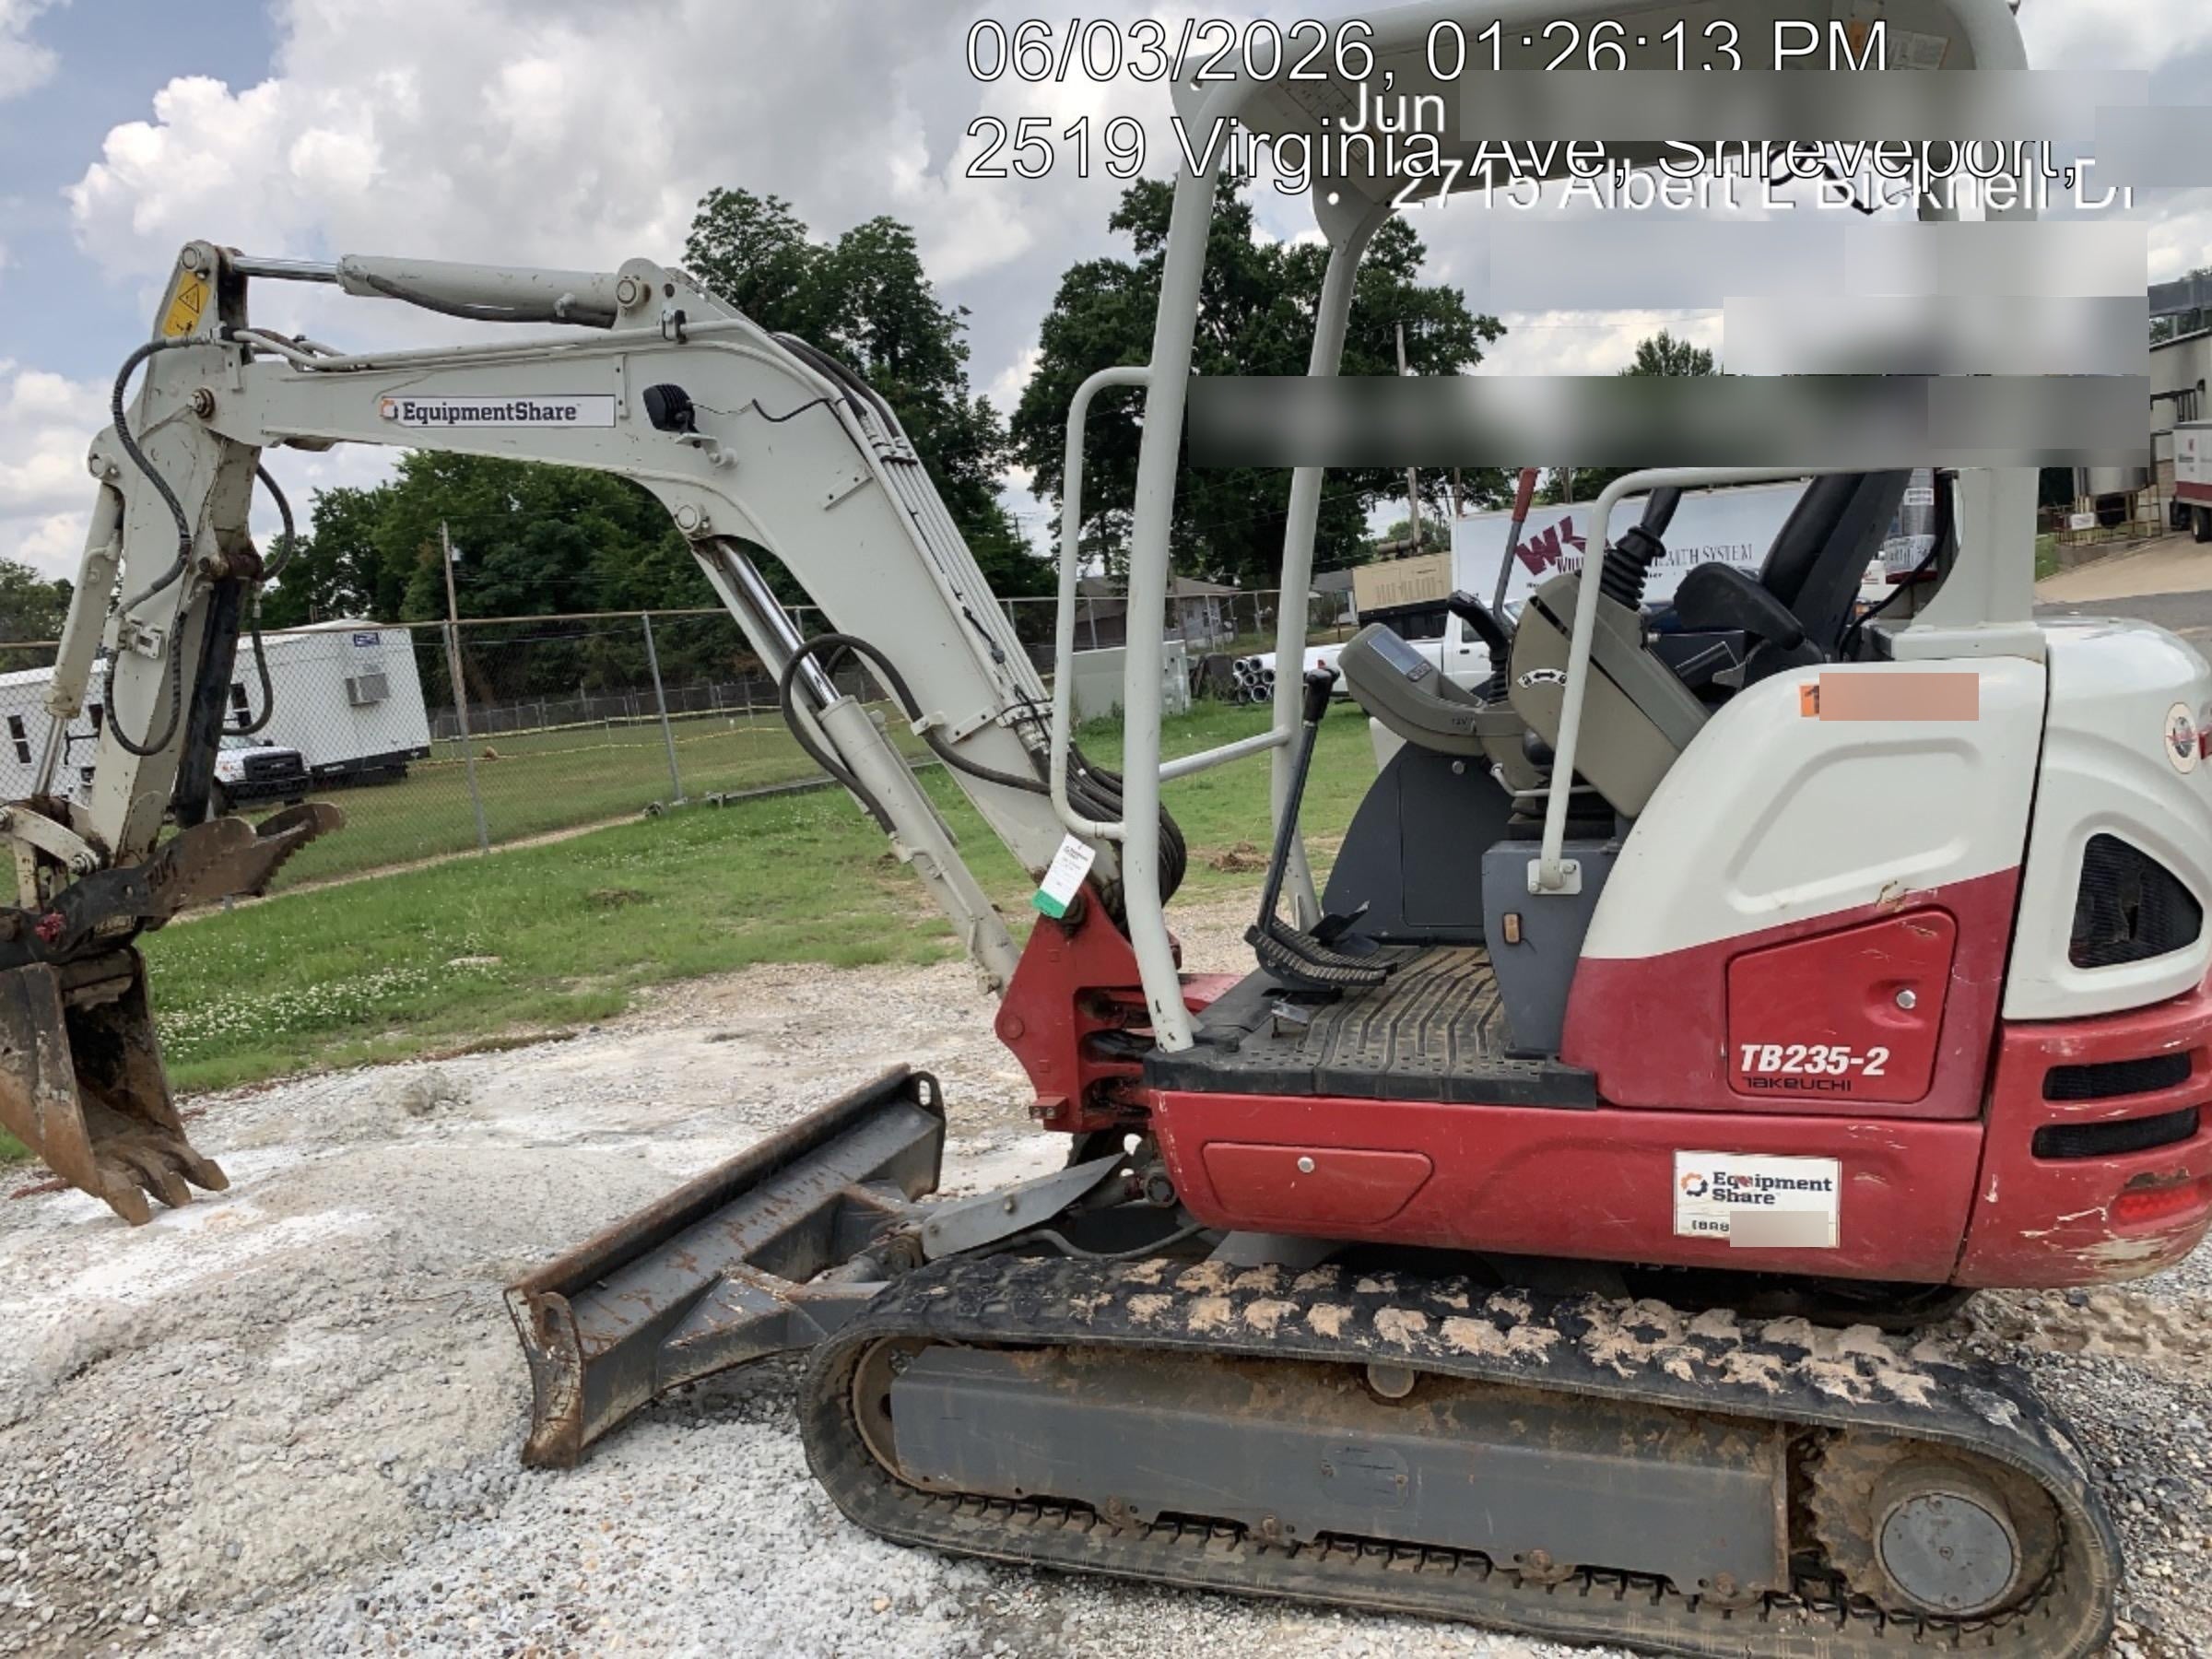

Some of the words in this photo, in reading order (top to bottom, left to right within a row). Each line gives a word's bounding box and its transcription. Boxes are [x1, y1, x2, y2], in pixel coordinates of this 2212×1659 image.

[403, 402, 577, 425] EquipmentShare
[1702, 543, 1753, 561] SYSTEM
[1740, 1044, 1888, 1076] TB235-2
[1712, 1188, 1776, 1205] Share
